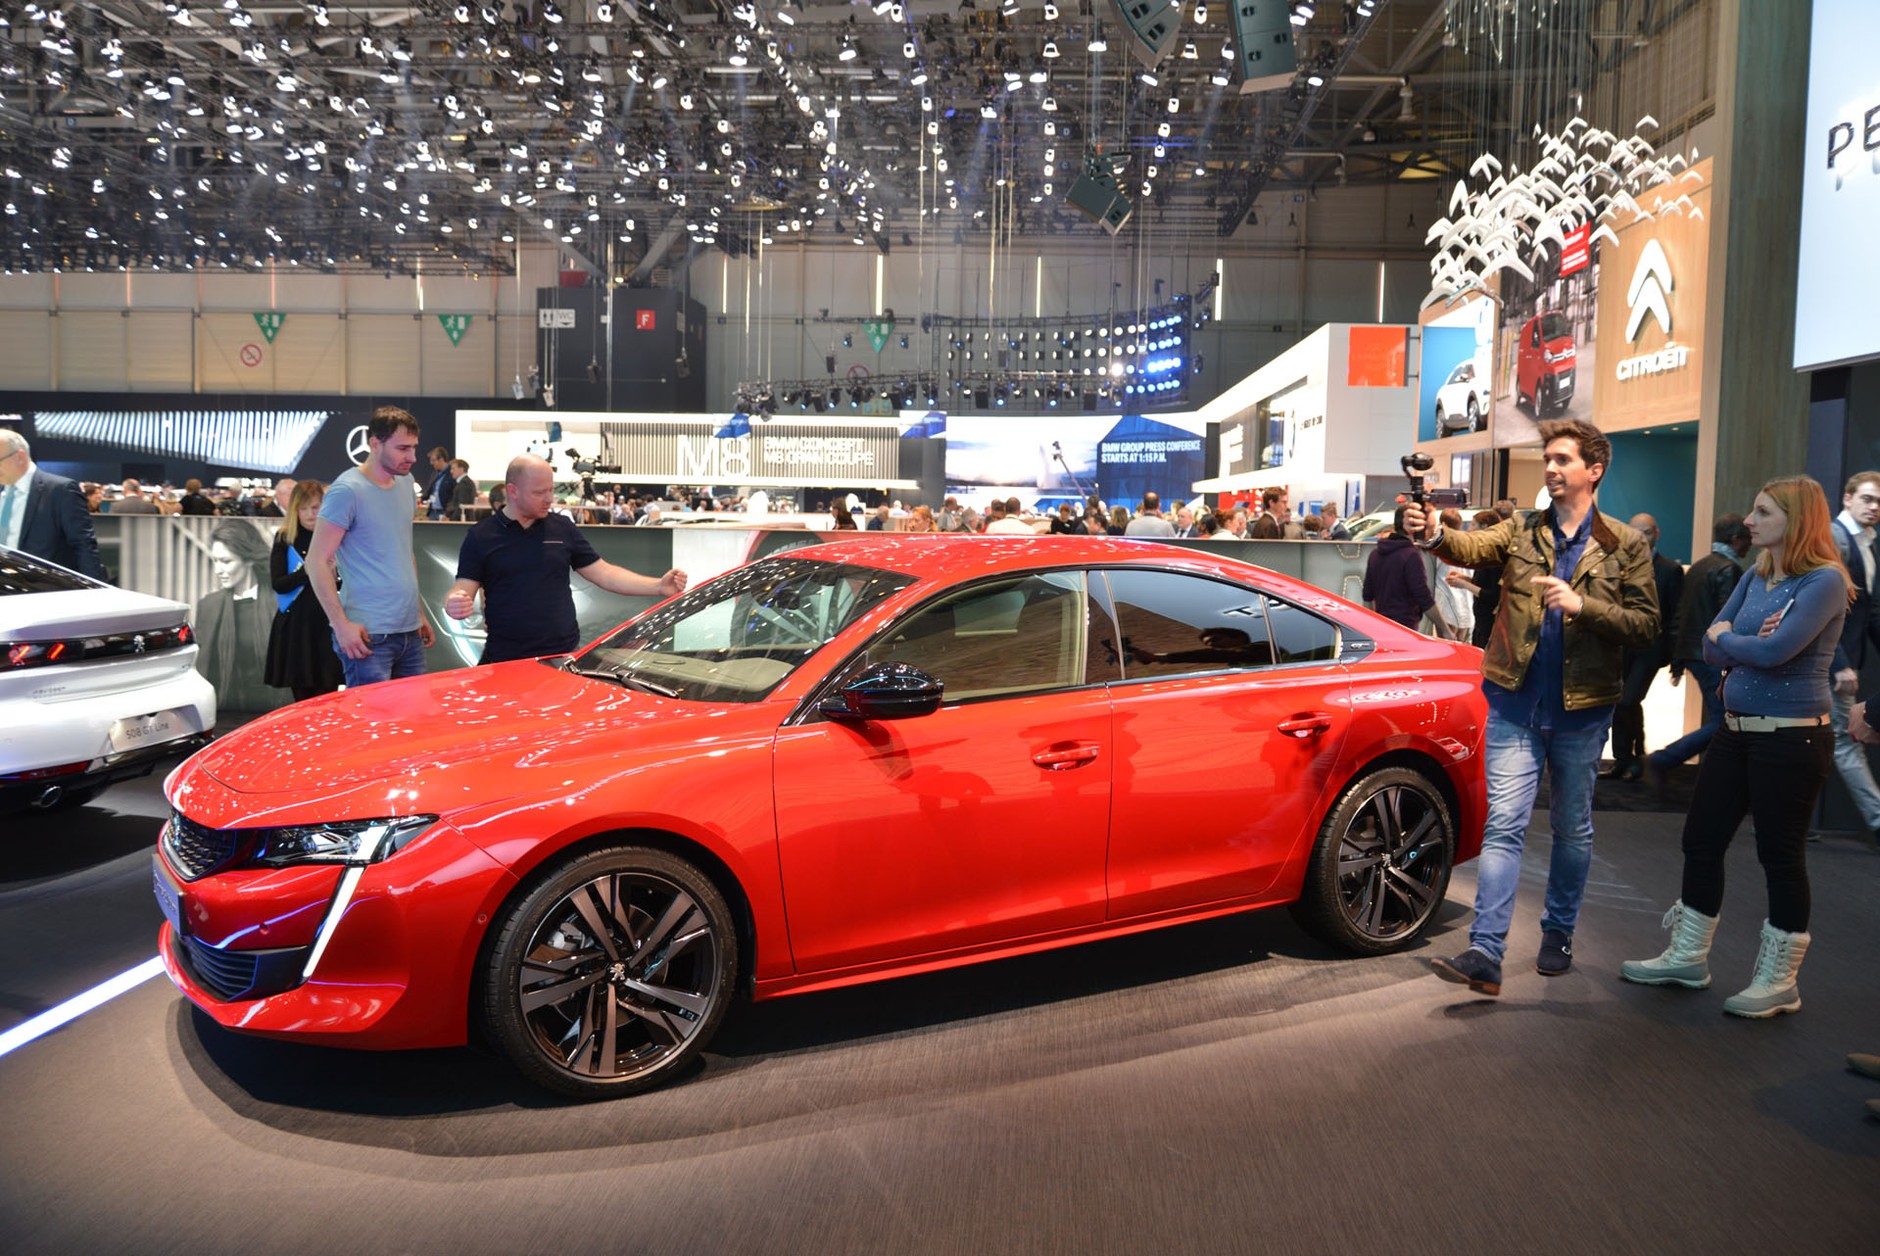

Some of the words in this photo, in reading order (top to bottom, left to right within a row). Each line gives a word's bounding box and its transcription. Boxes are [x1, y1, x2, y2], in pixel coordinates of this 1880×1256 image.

[557, 311, 574, 319] WC
[641, 313, 650, 326] F
[764, 436, 799, 449] BMW
[1102, 442, 1120, 452] BMW
[1121, 441, 1145, 452] GROUP
[1145, 441, 1166, 452] PRESS
[1167, 440, 1201, 452] CONFERENCE
[677, 434, 750, 477] M8
[1102, 453, 1128, 463] STARTS
[1129, 453, 1138, 463] AT
[1139, 453, 1153, 463] 1:15
[1153, 453, 1167, 463] P.M.
[126, 727, 142, 740] 508
